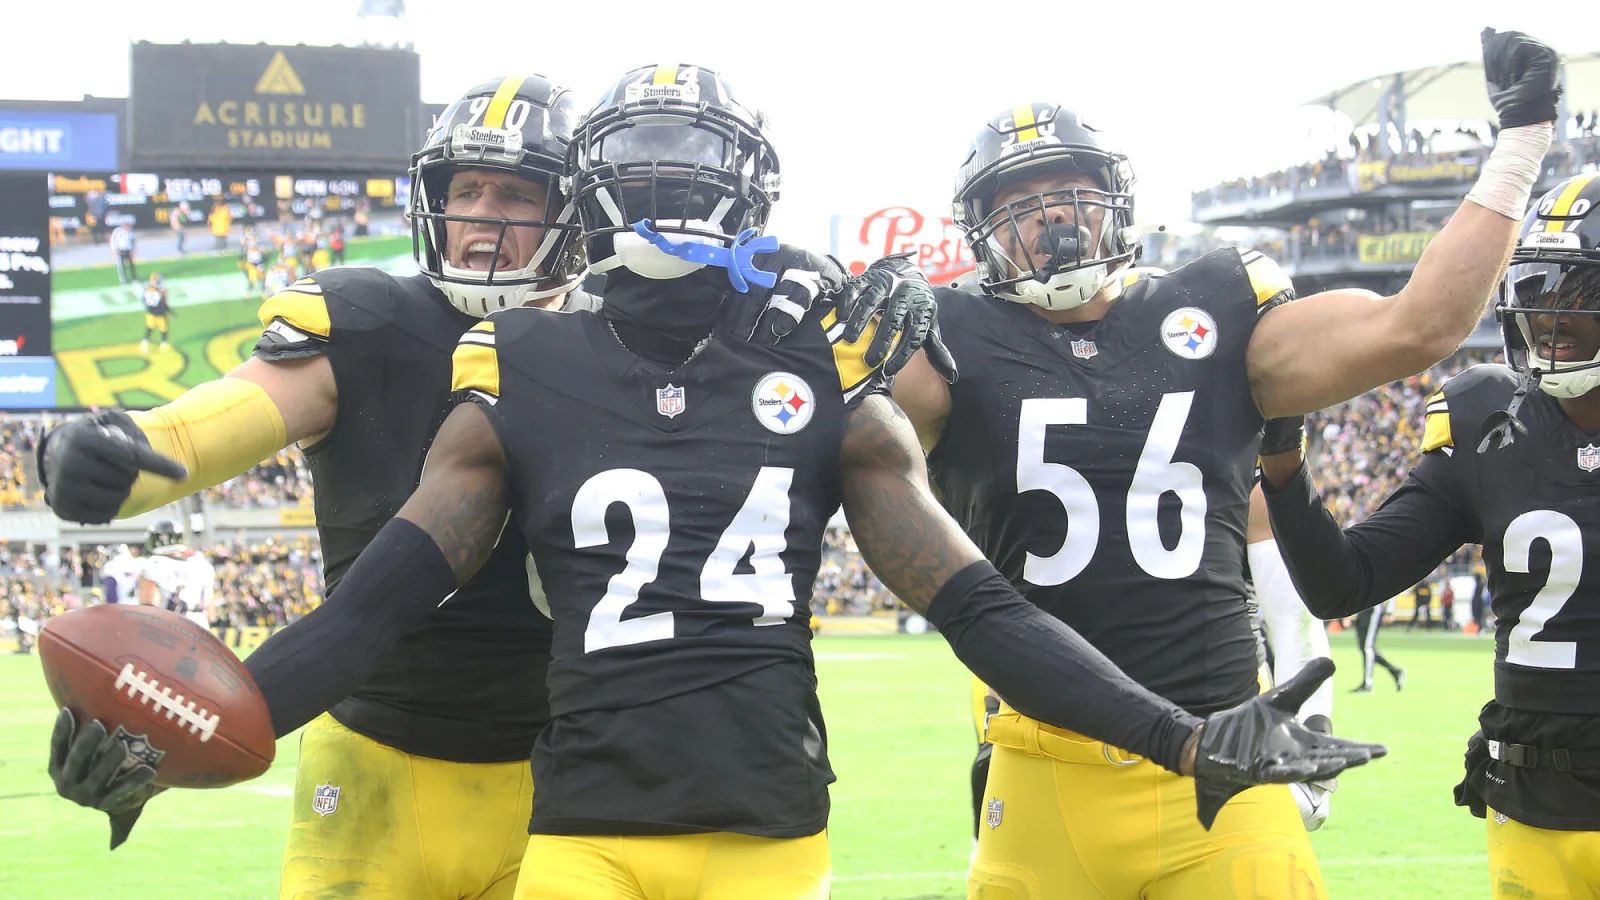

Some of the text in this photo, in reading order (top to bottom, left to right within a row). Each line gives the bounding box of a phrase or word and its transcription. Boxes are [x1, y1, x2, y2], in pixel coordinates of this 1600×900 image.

[625, 66, 700, 85] 24
[643, 86, 681, 98] Steelers
[193, 102, 367, 129] ACRISURE
[467, 97, 531, 130] 90
[227, 130, 333, 149] STADIUM
[470, 128, 505, 144] Steelers
[1166, 330, 1189, 339] Steelers
[758, 397, 783, 407] Steelers
[1016, 390, 1208, 587] 56
[571, 466, 797, 654] 24
